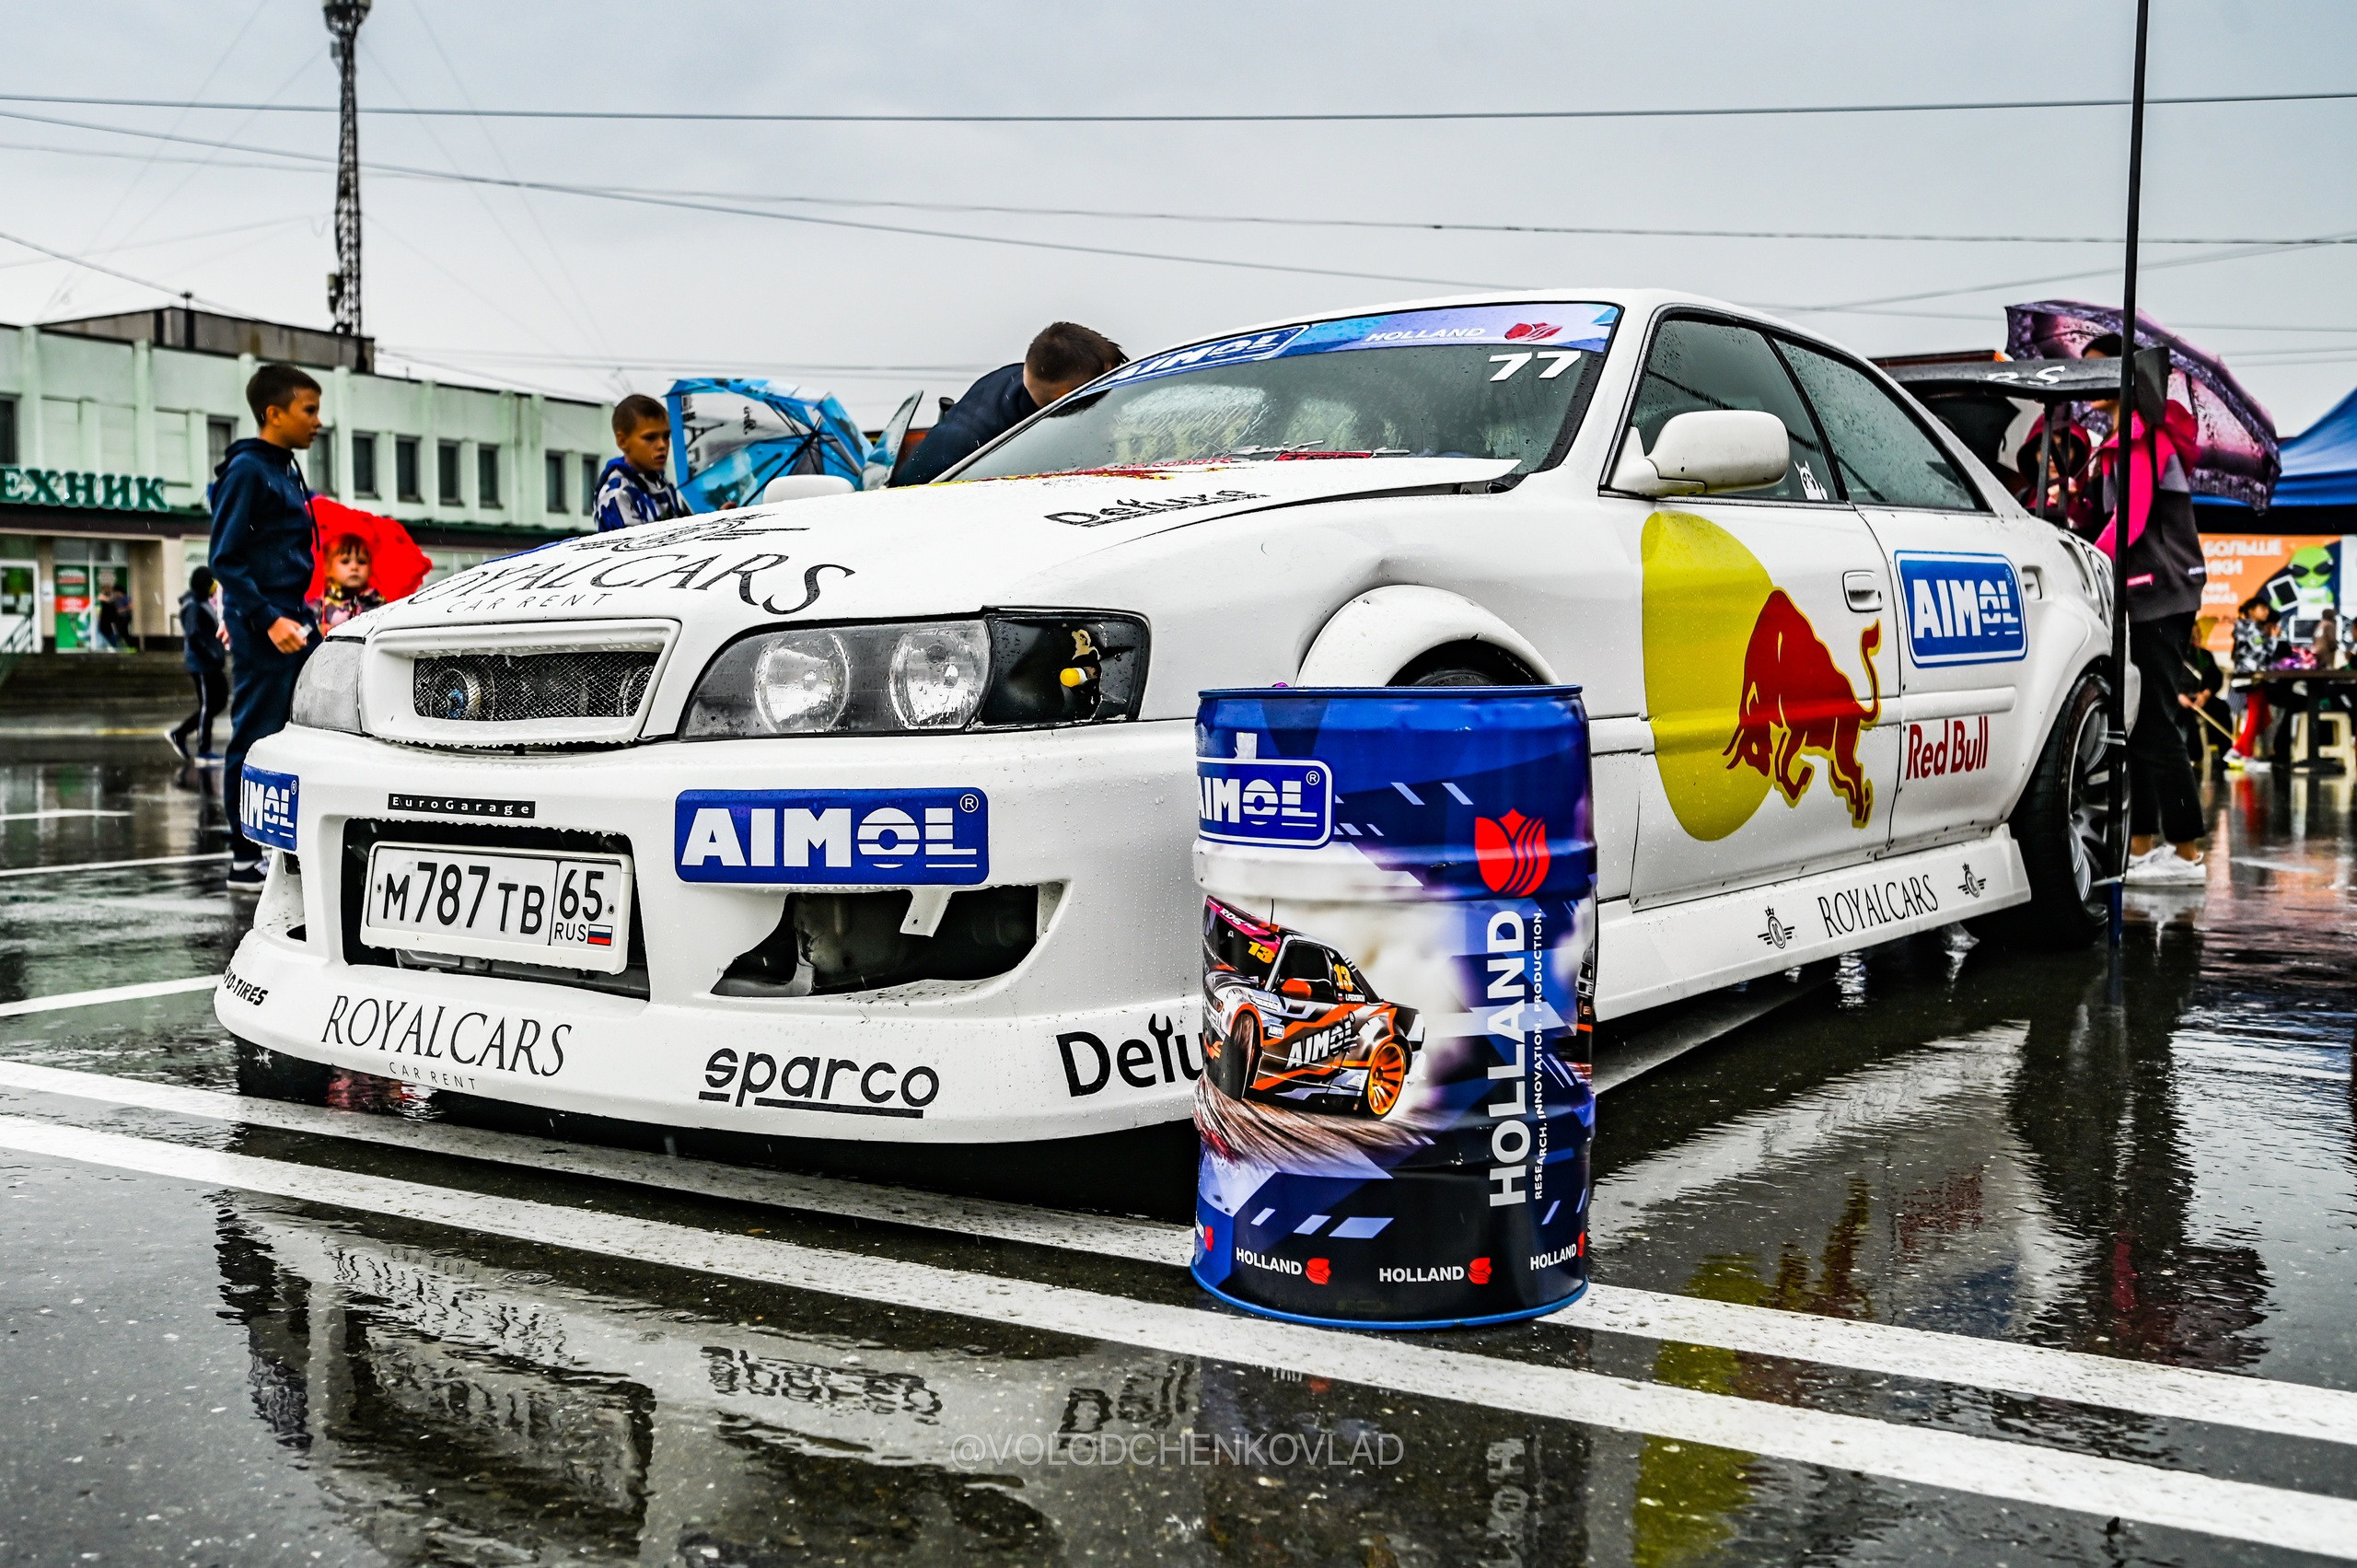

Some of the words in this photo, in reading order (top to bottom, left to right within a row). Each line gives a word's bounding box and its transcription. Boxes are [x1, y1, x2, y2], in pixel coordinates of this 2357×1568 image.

[1365, 328, 1486, 342] HOLLAND
[1489, 350, 1582, 382] 77
[447, 598, 505, 613] CAR
[517, 594, 613, 609] RENT
[1912, 579, 2020, 639] AIMOL
[1905, 719, 1949, 781] Red
[1950, 715, 1989, 773] Bull
[240, 776, 295, 838] IMOL
[392, 796, 530, 816] EuroGarage
[680, 807, 978, 869] AIMOL
[559, 869, 605, 922] 65
[554, 923, 587, 943] RUS
[1248, 941, 1275, 963] 13
[1333, 963, 1353, 992] 13
[321, 995, 573, 1076] ROYALCARS
[1284, 1019, 1360, 1070] AIMOL
[1487, 911, 1531, 1207] HOLLAND
[389, 1062, 421, 1079] CAR
[431, 1071, 477, 1090] RENT
[700, 1047, 940, 1112] sparco
[1236, 1247, 1303, 1275] HOLLAND
[1530, 1243, 1576, 1271] HOLLAND
[1379, 1266, 1465, 1282] HOLLAND
